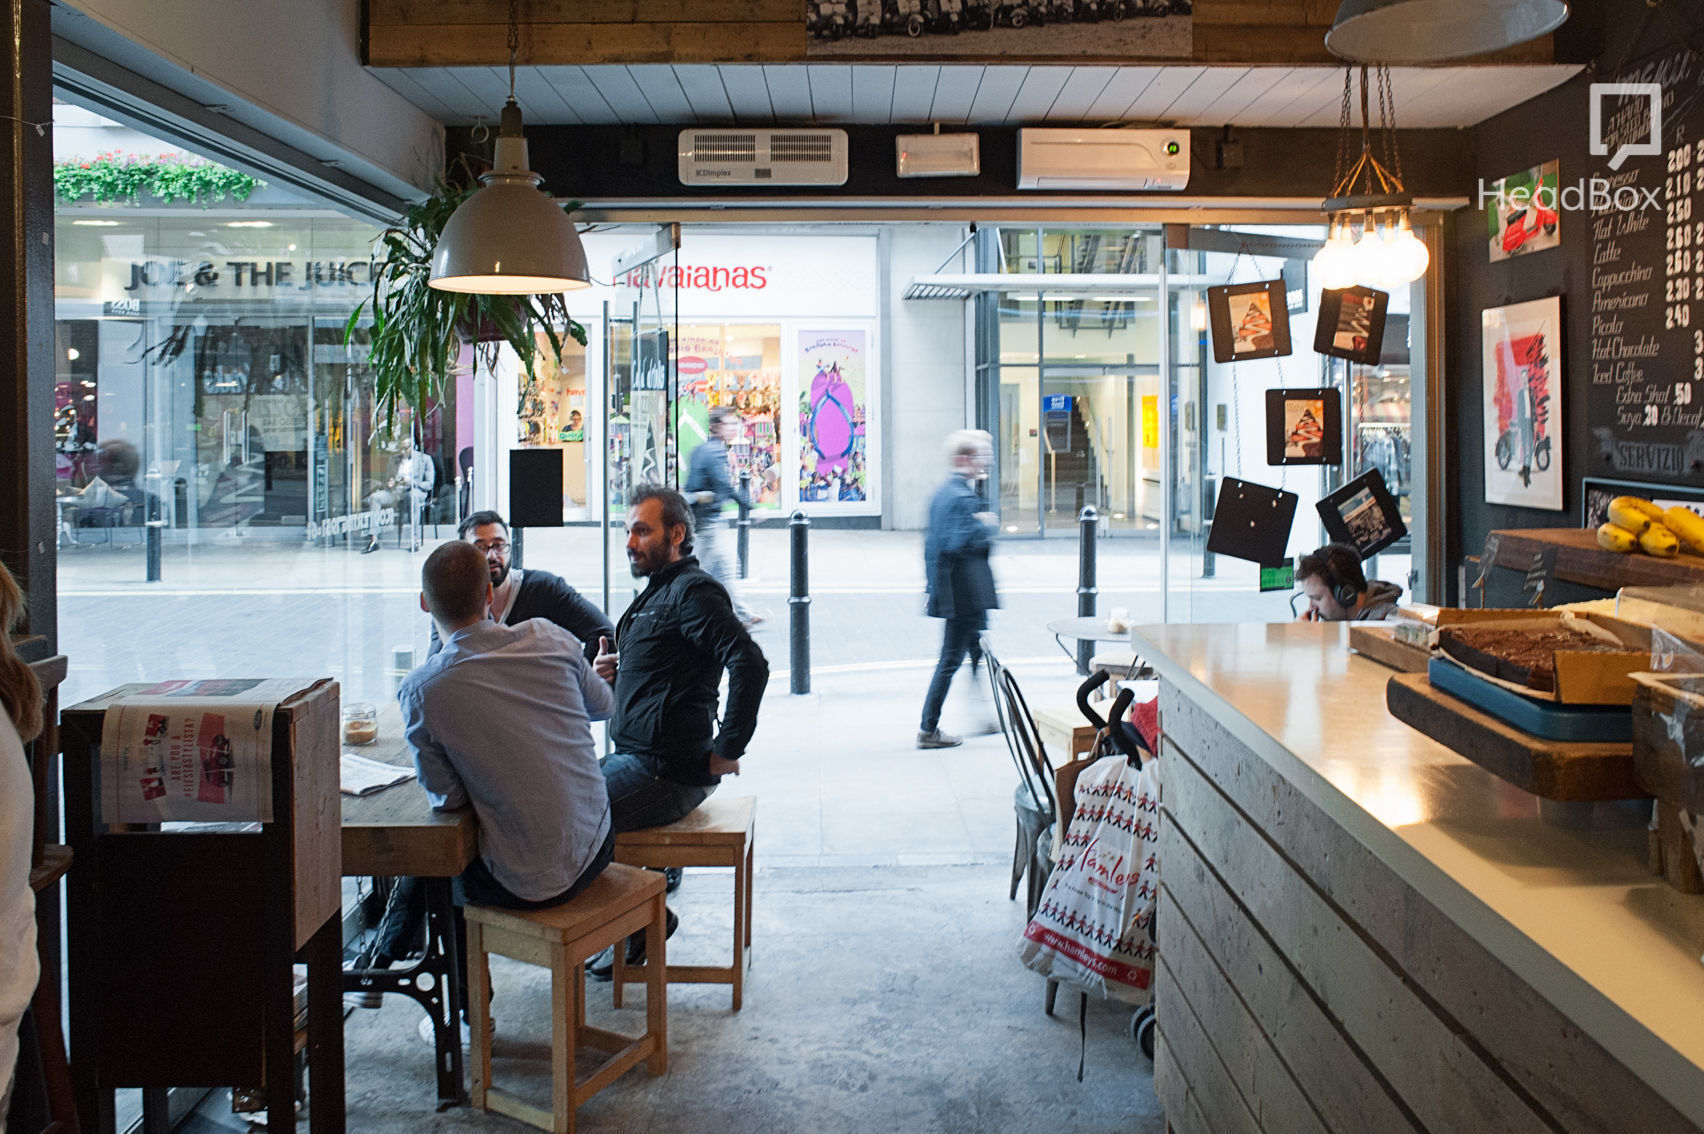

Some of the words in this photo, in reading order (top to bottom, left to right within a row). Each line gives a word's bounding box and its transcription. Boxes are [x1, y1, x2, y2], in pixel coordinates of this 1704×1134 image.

[1616, 210, 1649, 236] White
[1593, 239, 1621, 265] Latte
[227, 261, 292, 287] THE
[1592, 290, 1649, 313] Americano
[1592, 337, 1612, 361] Hot
[1611, 335, 1660, 360] Chocolate
[1615, 361, 1644, 386] Coffee
[1616, 384, 1642, 404] Extra
[1644, 384, 1671, 404] Shot
[1619, 443, 1685, 474] SERVIZIO
[171, 744, 181, 761] YOU
[171, 764, 181, 781] ARE
[1044, 932, 1118, 976] www.hamleys.com
